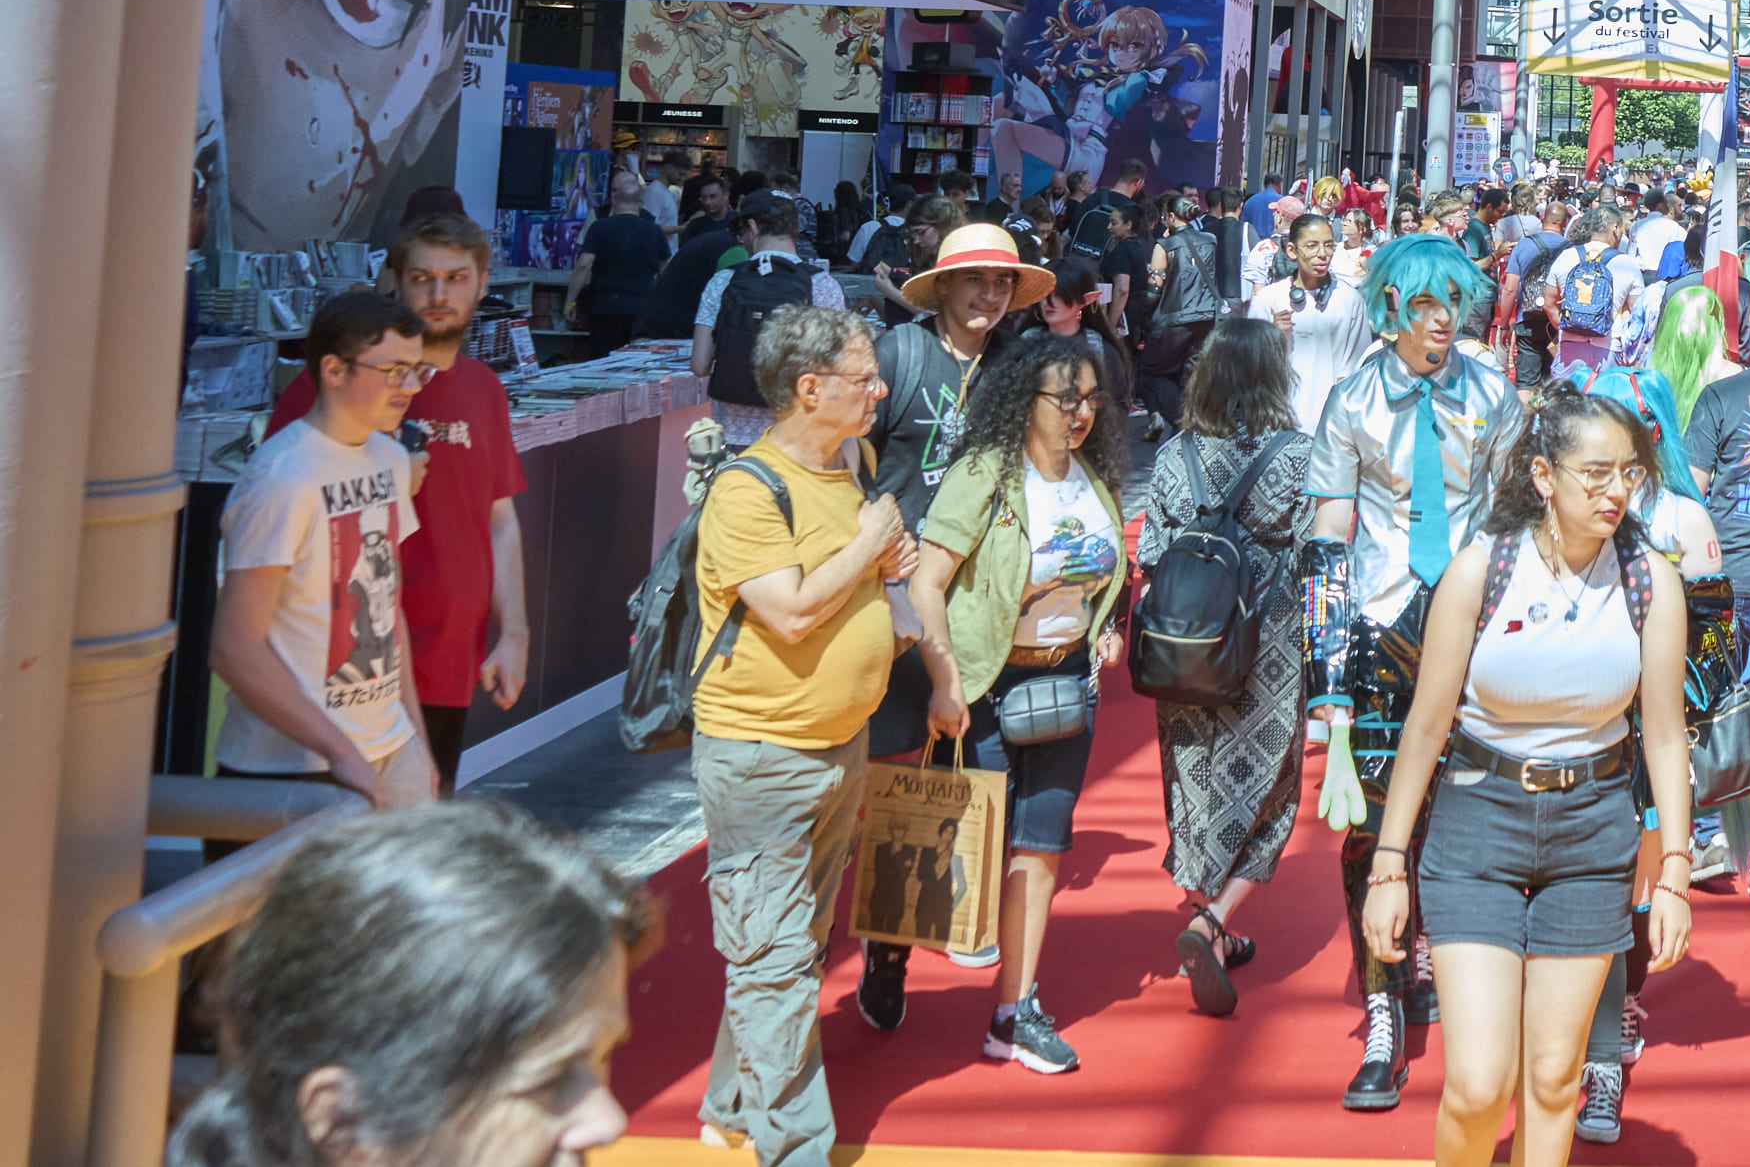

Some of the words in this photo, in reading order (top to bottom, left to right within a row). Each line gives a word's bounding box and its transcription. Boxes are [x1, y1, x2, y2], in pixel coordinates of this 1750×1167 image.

[1588, 0, 1678, 24] Sortie
[1595, 26, 1611, 36] du
[1617, 27, 1669, 39] festival
[662, 110, 703, 118] JEUNESSE
[818, 117, 859, 125] NINTENDO
